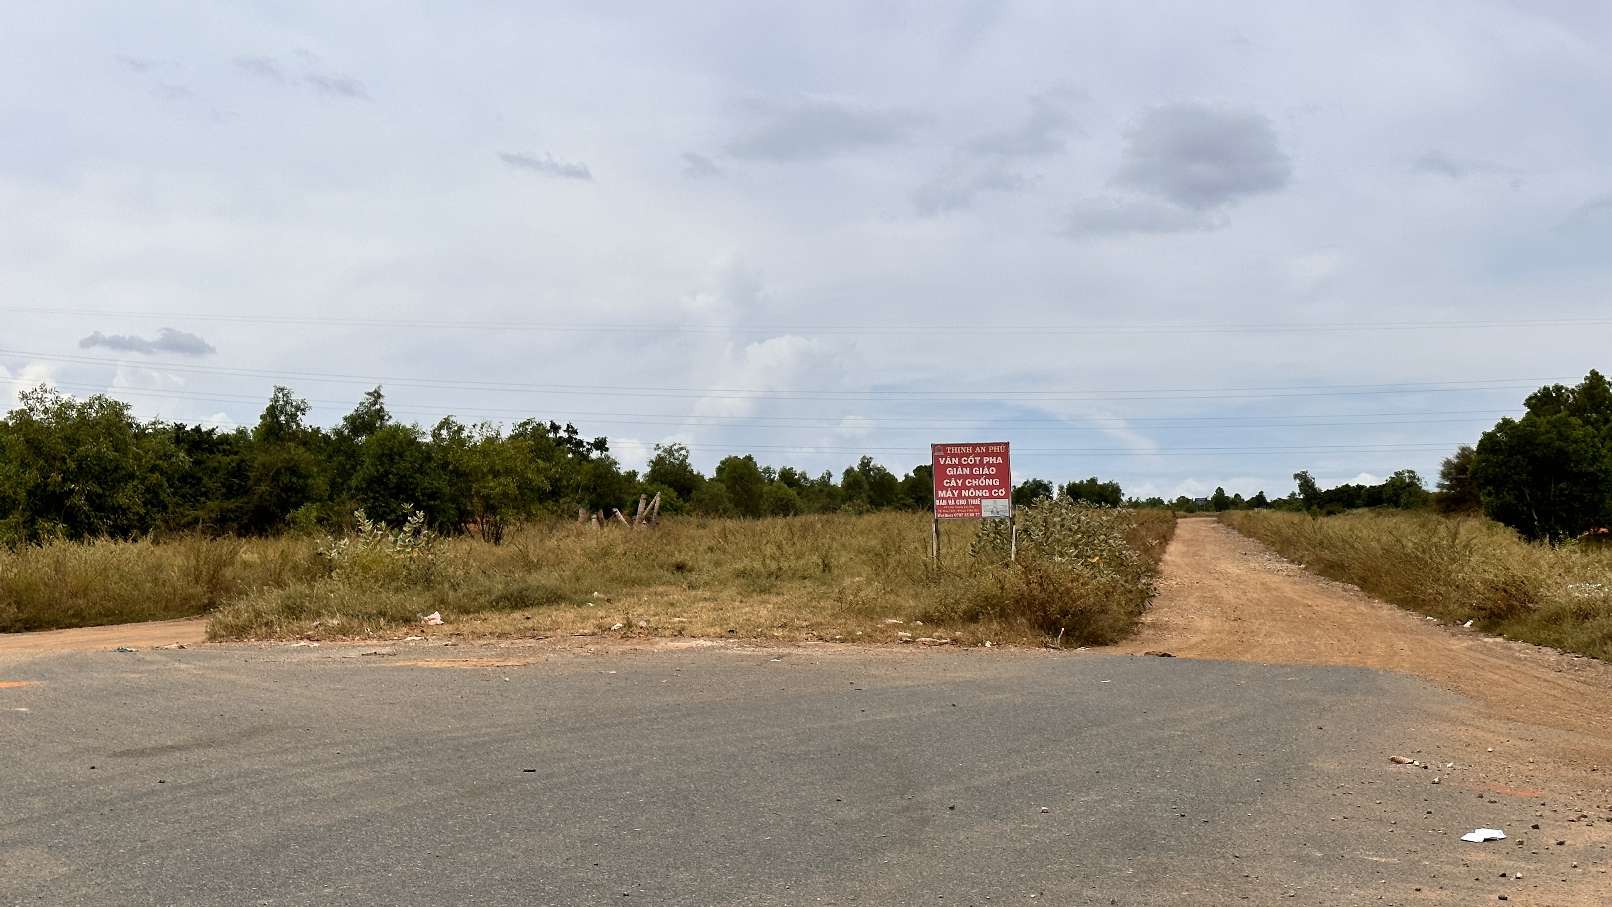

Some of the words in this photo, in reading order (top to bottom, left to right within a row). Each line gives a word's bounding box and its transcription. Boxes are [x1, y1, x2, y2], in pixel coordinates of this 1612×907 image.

[961, 454, 981, 464] CỐT
[983, 456, 1003, 464] PHA
[965, 476, 1000, 486] CHỐNG
